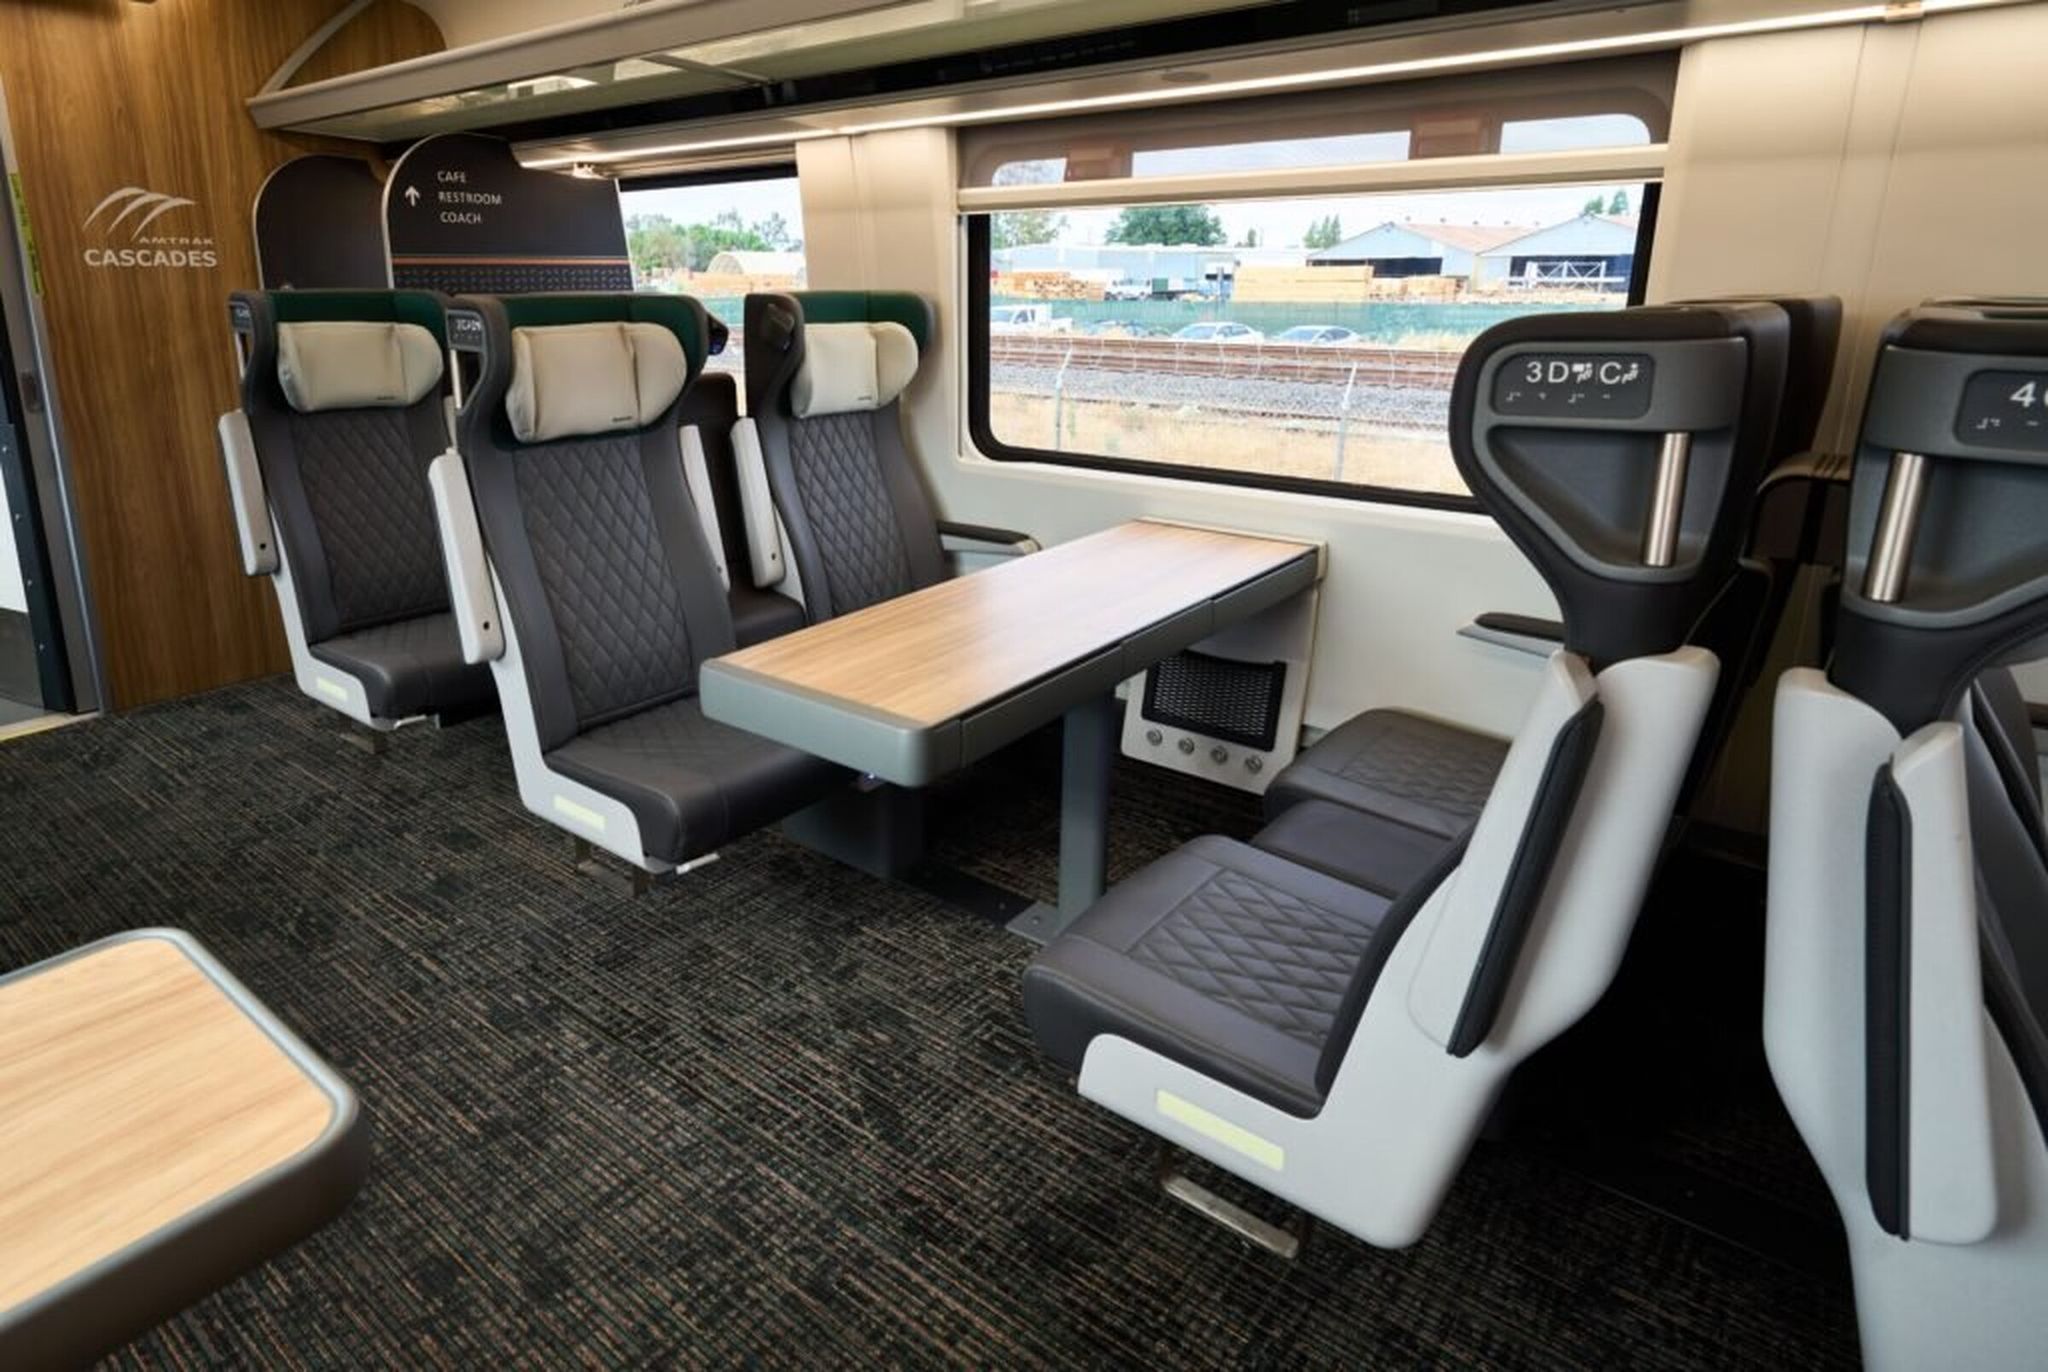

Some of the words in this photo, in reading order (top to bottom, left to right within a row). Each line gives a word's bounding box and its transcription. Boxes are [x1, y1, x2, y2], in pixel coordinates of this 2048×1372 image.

[437, 170, 466, 183] CAFE
[438, 191, 502, 205] RESTROOM
[440, 211, 482, 224] COACH
[139, 236, 213, 245] AMTRAK
[83, 248, 217, 268] CASCADES
[2008, 380, 2048, 408] 4
